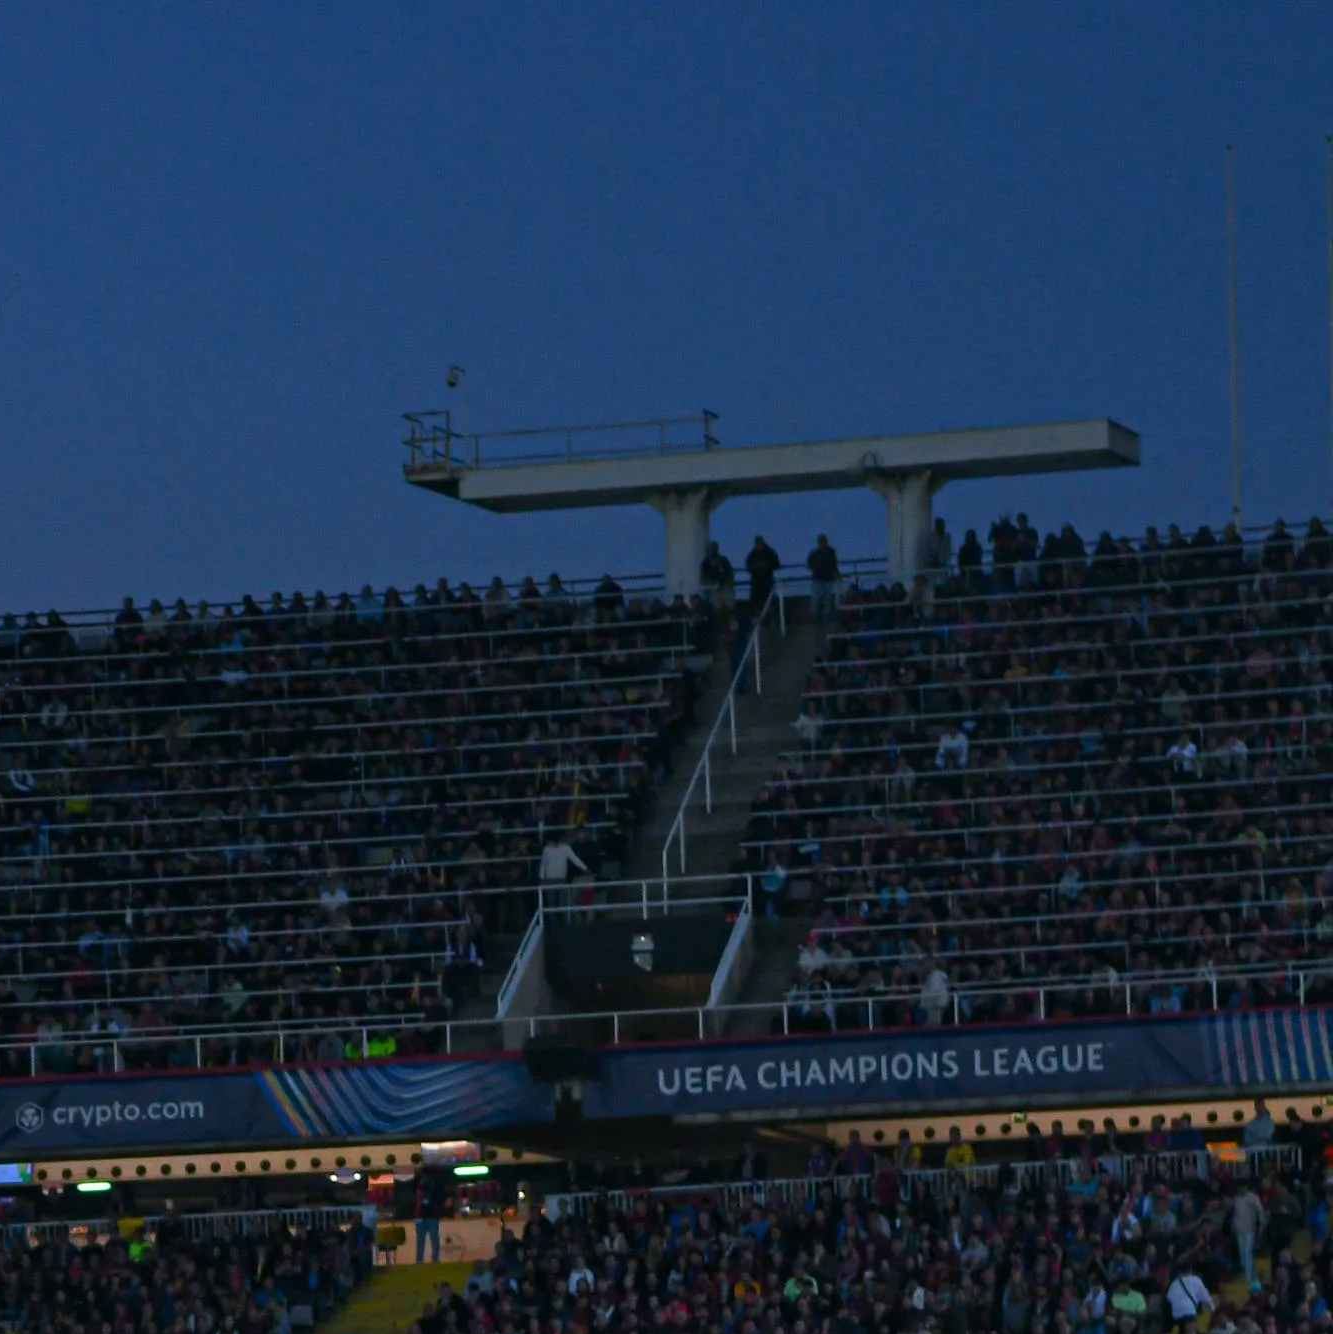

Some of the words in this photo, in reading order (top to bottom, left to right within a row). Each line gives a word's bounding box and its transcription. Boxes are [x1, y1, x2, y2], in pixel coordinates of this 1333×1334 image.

[657, 1063, 747, 1096] UEFA
[757, 1050, 960, 1091] CHAMPIONS
[974, 1042, 1104, 1077] LEAGUE
[52, 1100, 205, 1127] crypto.com
